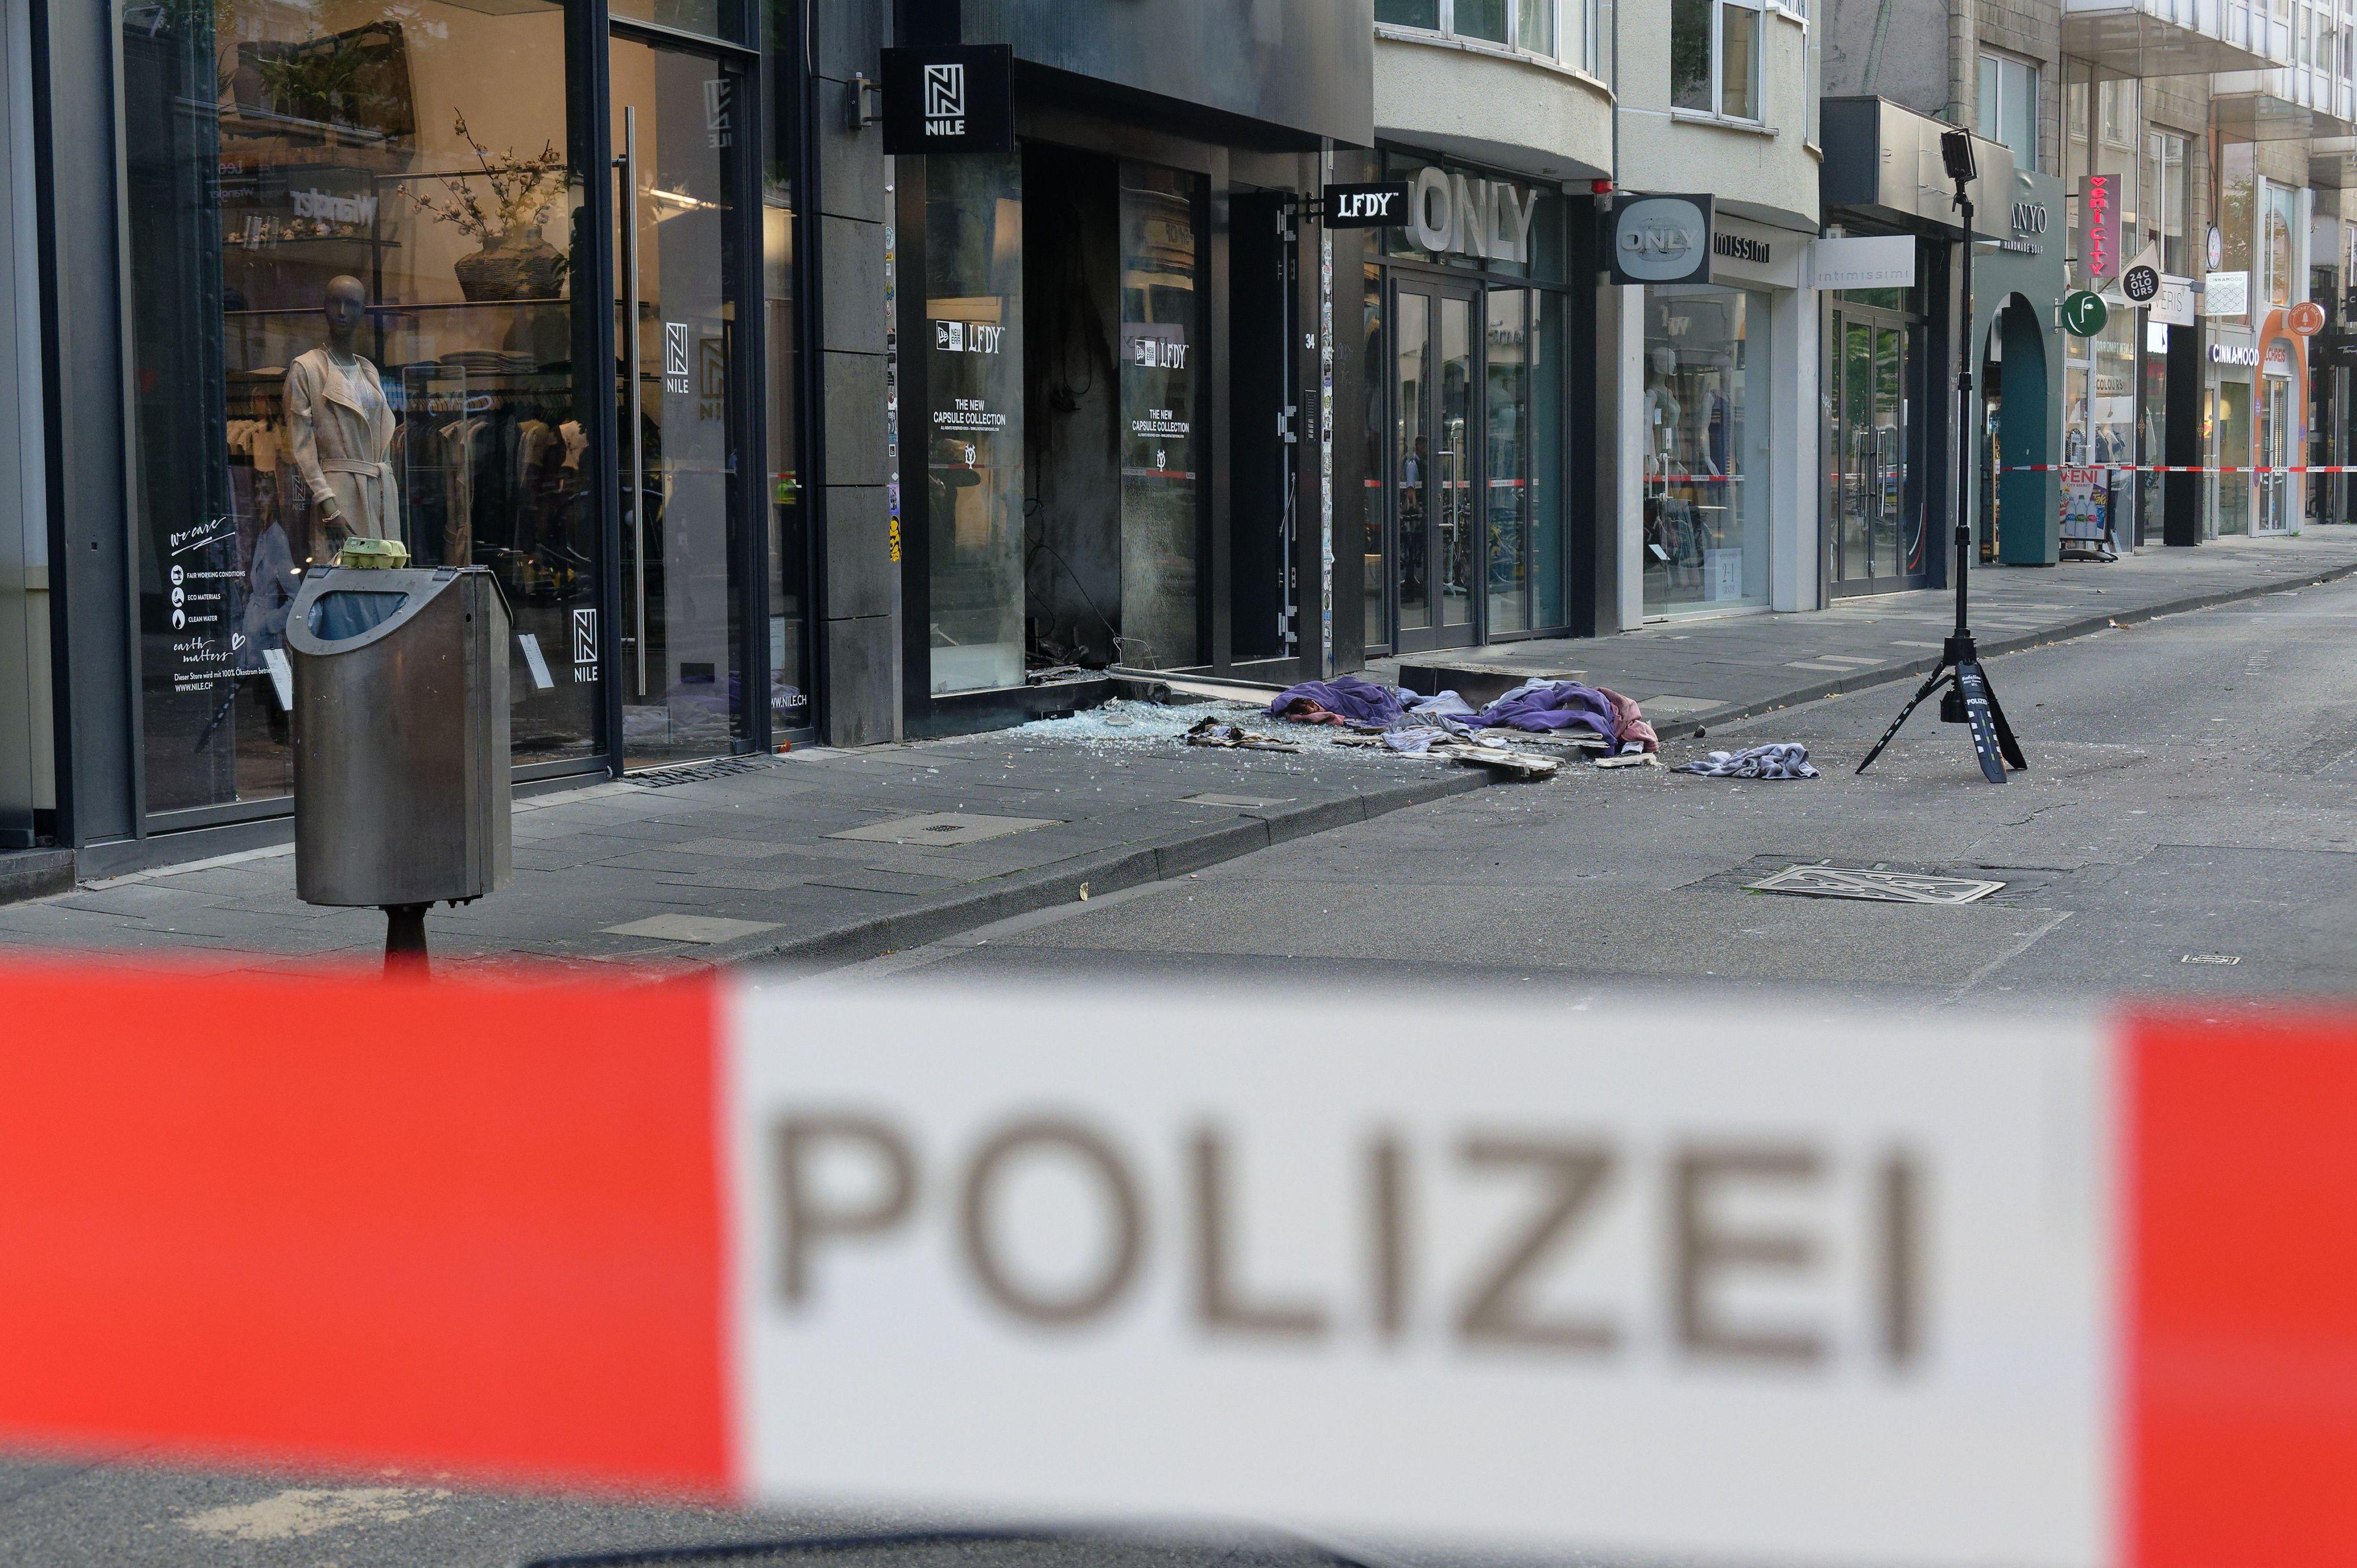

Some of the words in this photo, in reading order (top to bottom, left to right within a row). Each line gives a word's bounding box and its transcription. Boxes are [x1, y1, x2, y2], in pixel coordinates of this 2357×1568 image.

[925, 120, 965, 136] NILE
[1415, 166, 1537, 263] ONLY
[1621, 227, 1701, 250] ONLY
[2004, 240, 2030, 253] HANDMADE
[2031, 244, 2044, 255] SOAP
[1818, 270, 1909, 282] intimissimi
[951, 328, 961, 336] NEW
[1305, 333, 1315, 349] 34
[2213, 344, 2260, 366] CINNAMOOD
[666, 378, 689, 394] NILE
[955, 399, 968, 410] THE
[969, 400, 985, 411] NEW
[933, 411, 964, 423] CAPSULE
[965, 412, 1006, 425] COLLECTION
[1149, 409, 1160, 419] THE
[1160, 410, 1173, 420] NEW
[1132, 420, 1157, 431] CAPSULE
[1157, 421, 1190, 433] COLLECTION
[2060, 469, 2098, 483] VENI
[292, 502, 306, 511] NILE
[170, 531, 190, 547] we
[191, 517, 227, 537] care
[173, 636, 215, 651] earth
[183, 649, 233, 663] matters
[174, 673, 189, 681] Dieser
[190, 672, 203, 680] Store
[222, 669, 235, 678] 100%
[235, 666, 258, 676] Ökostrom
[575, 666, 598, 683] NILE
[175, 682, 213, 692] WWW.NILE.CH
[770, 1108, 1924, 1370] POLIZEI
